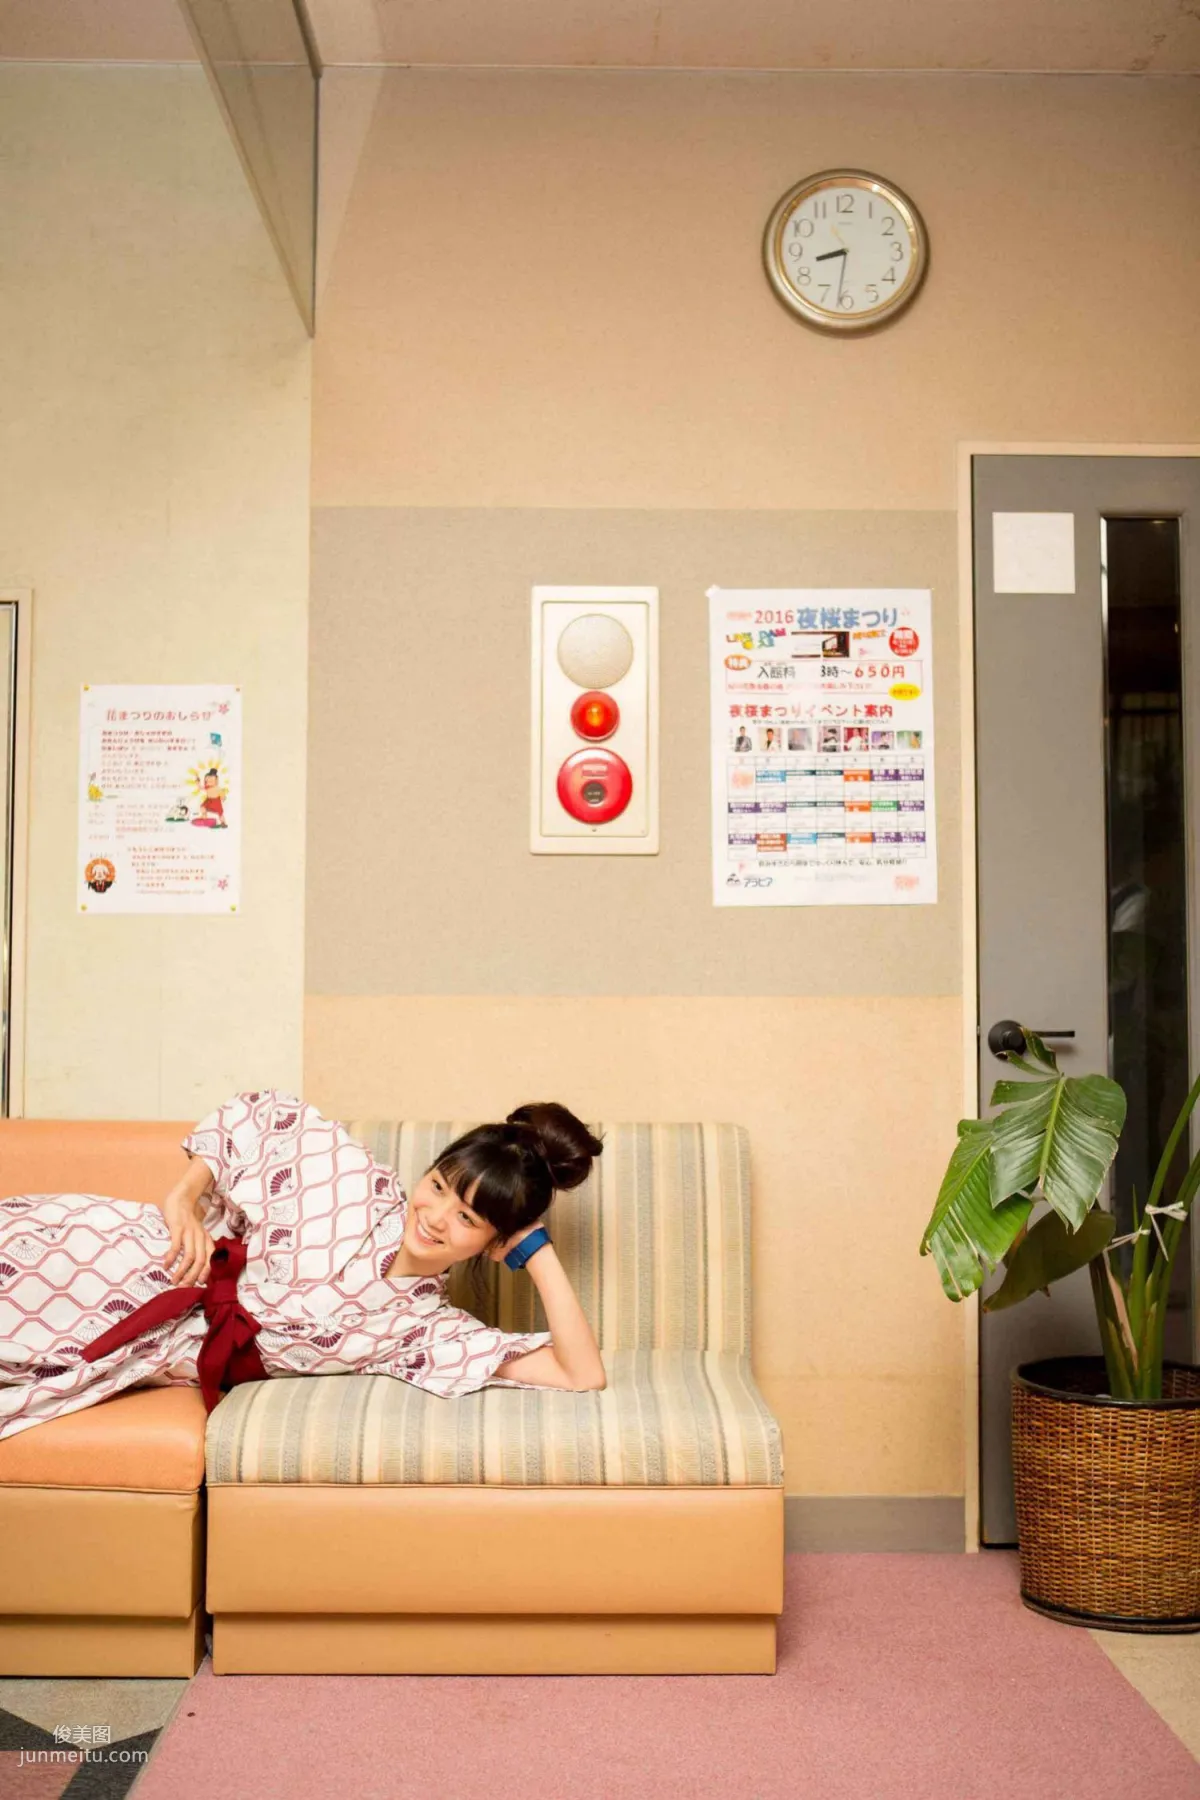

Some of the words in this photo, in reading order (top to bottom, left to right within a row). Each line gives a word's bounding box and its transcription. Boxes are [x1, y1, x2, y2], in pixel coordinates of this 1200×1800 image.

[814, 201, 827, 219] 11
[836, 194, 854, 213] 12
[868, 201, 873, 219] 1
[792, 218, 815, 238] 10
[881, 217, 895, 236] 2
[788, 242, 803, 262] 9
[890, 241, 903, 262] 3
[797, 266, 812, 286] 8
[881, 267, 896, 285] 4
[817, 284, 832, 304] 7
[840, 290, 854, 310] 6
[865, 284, 879, 303] 5
[754, 610, 794, 624] 2016
[797, 607, 898, 629] 夜桜まつり
